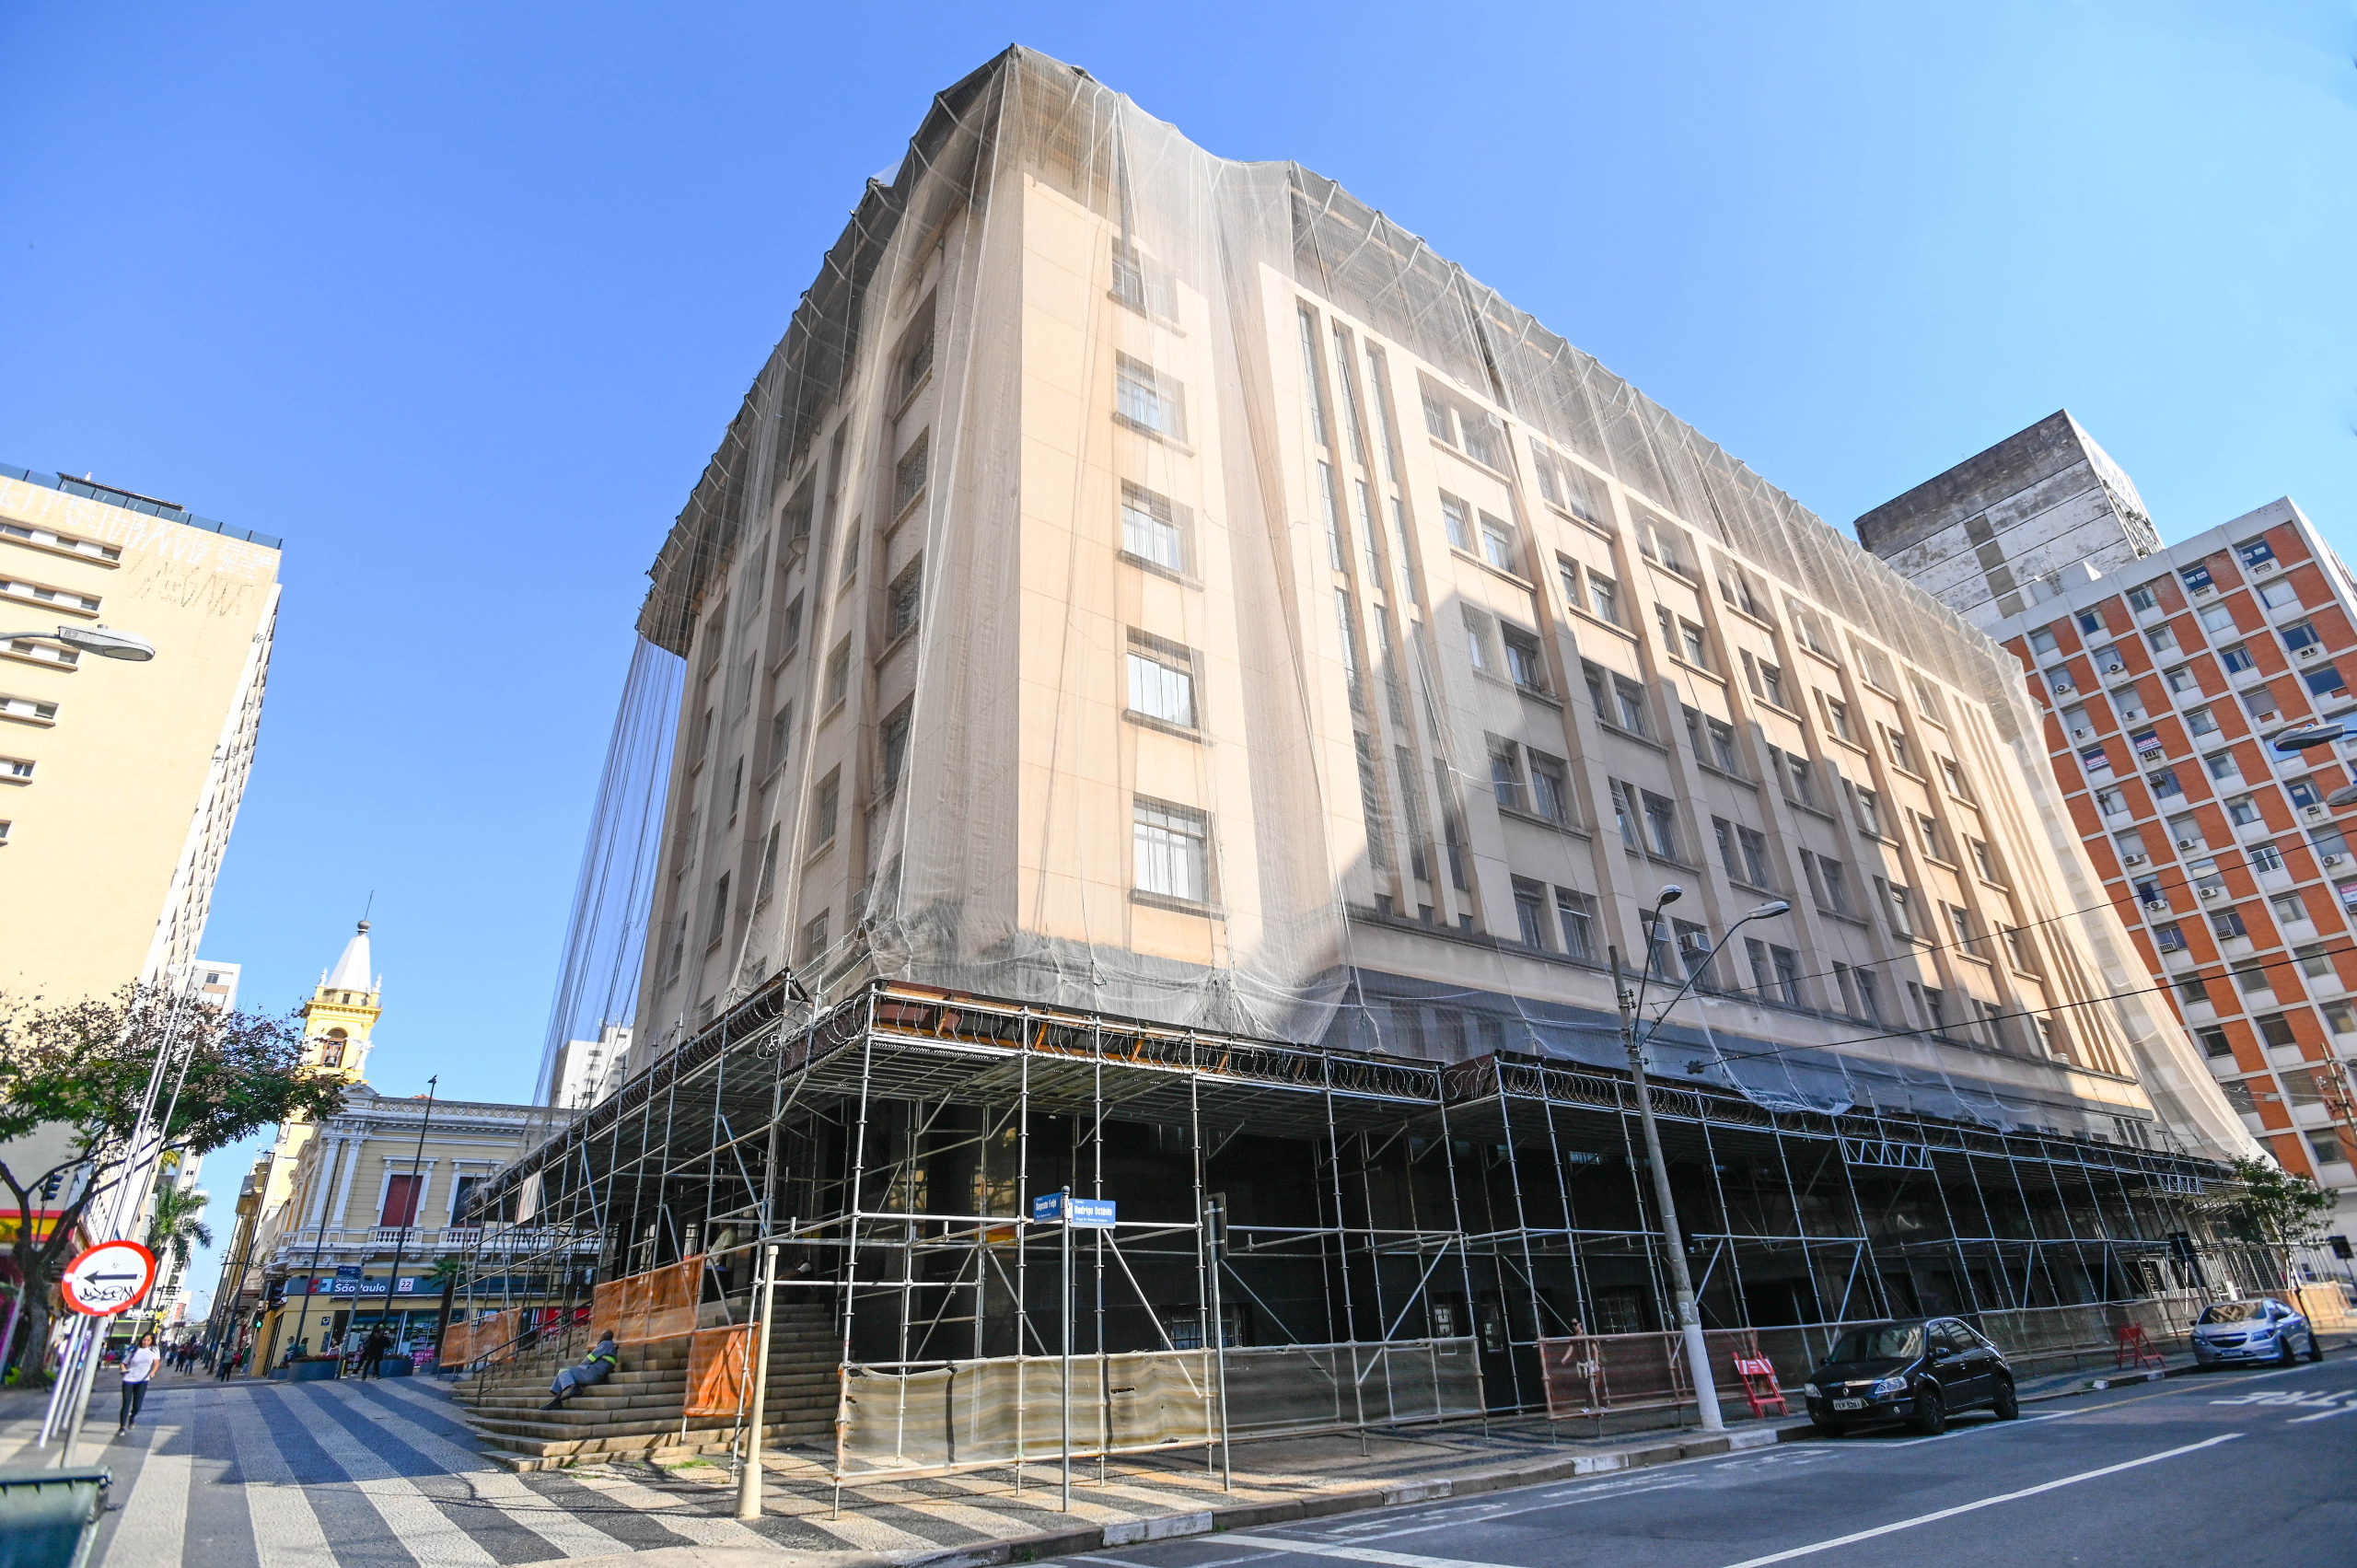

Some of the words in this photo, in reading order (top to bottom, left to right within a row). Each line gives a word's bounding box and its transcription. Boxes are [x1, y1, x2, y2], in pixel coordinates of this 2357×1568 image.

[1074, 1205, 1094, 1216] Rodrigo
[334, 1283, 355, 1293] São
[360, 1283, 386, 1293] aulo
